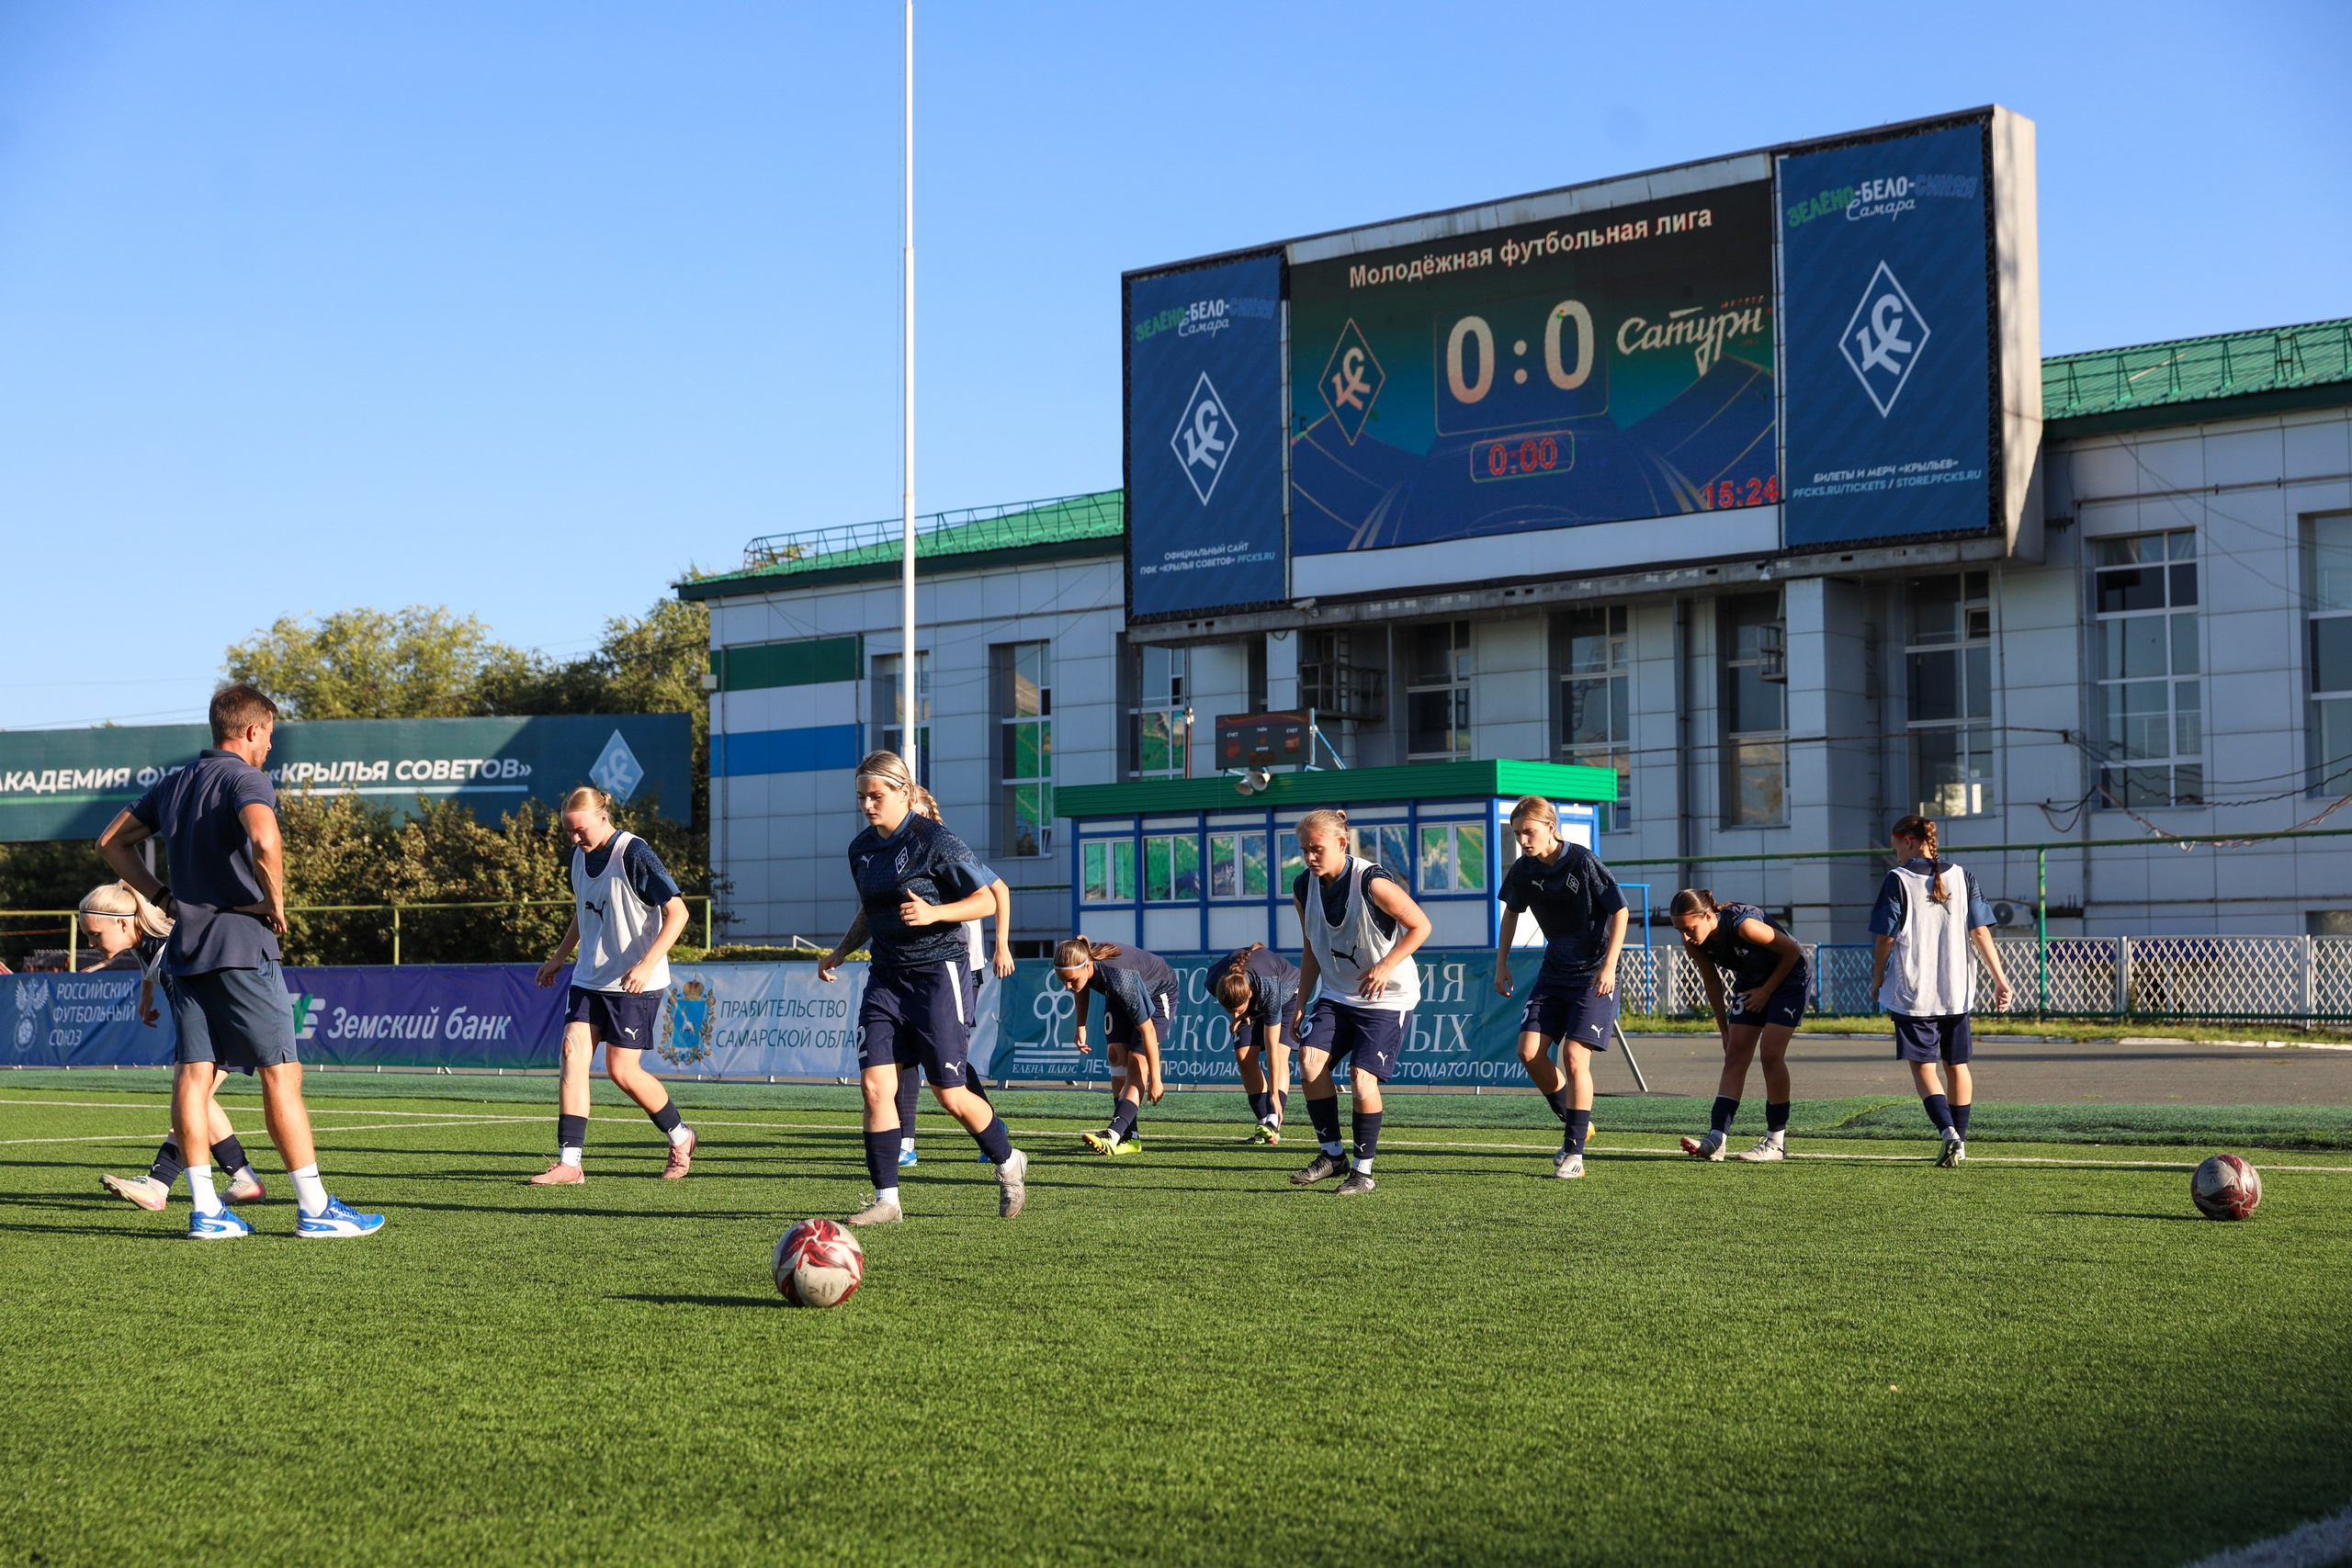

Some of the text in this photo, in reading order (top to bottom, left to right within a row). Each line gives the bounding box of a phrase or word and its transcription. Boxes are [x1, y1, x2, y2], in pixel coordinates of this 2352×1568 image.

[1846, 198, 1917, 222] Самара
[1349, 209, 1713, 288] Молодёжная футбольная лига
[1178, 317, 1230, 339] Самара
[1616, 306, 1765, 377] Сатурн
[1488, 437, 1558, 476] 0:00
[1814, 458, 1959, 484] БИЛЕТЫ И МЕРЧ «КРЫЛЬЕВ»
[1895, 469, 1983, 488] STORE.PFCKS.RU
[1702, 475, 1780, 510] 15:24
[1164, 541, 1250, 560] ОФИЦИАЛЬНЫЙ САЙТ
[1237, 551, 1276, 563] PFCKS.RU
[395, 758, 532, 781] СОВЕТОВ»
[56, 978, 135, 1000] РОССИЙСКИЙ
[52, 1000, 136, 1023] ФУТБОЛЬНЫЙ
[720, 999, 847, 1019] ПРАВИТЕЛЬСТВО
[326, 1005, 512, 1040] Земский банк
[49, 1029, 83, 1046] СОЮЗ
[716, 1026, 855, 1048] САМАРСКОЙ ОБЛА
[1012, 1064, 1079, 1074] ЕЛЕНА ПЛЮС
